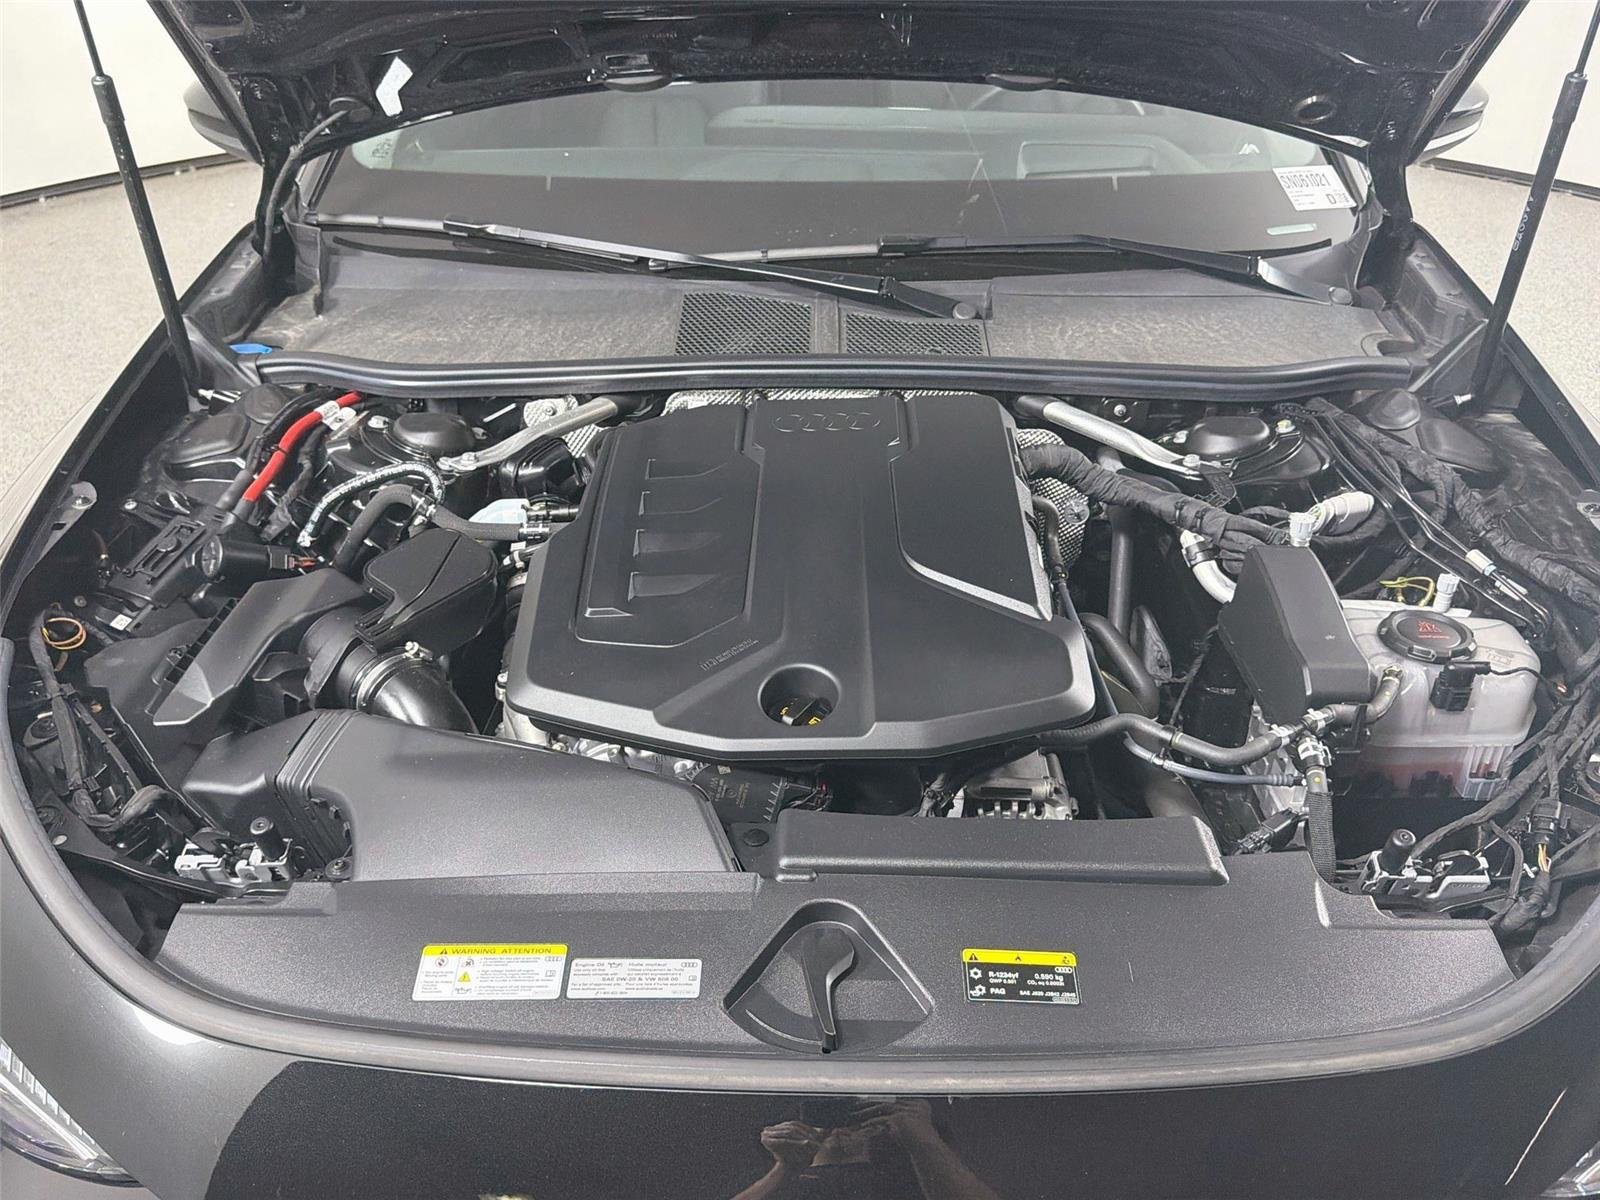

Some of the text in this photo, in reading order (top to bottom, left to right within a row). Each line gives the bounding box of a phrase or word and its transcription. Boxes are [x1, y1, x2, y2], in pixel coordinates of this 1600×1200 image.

[451, 947, 552, 955] WARNING ATTENTION
[989, 987, 1006, 995] PAG
